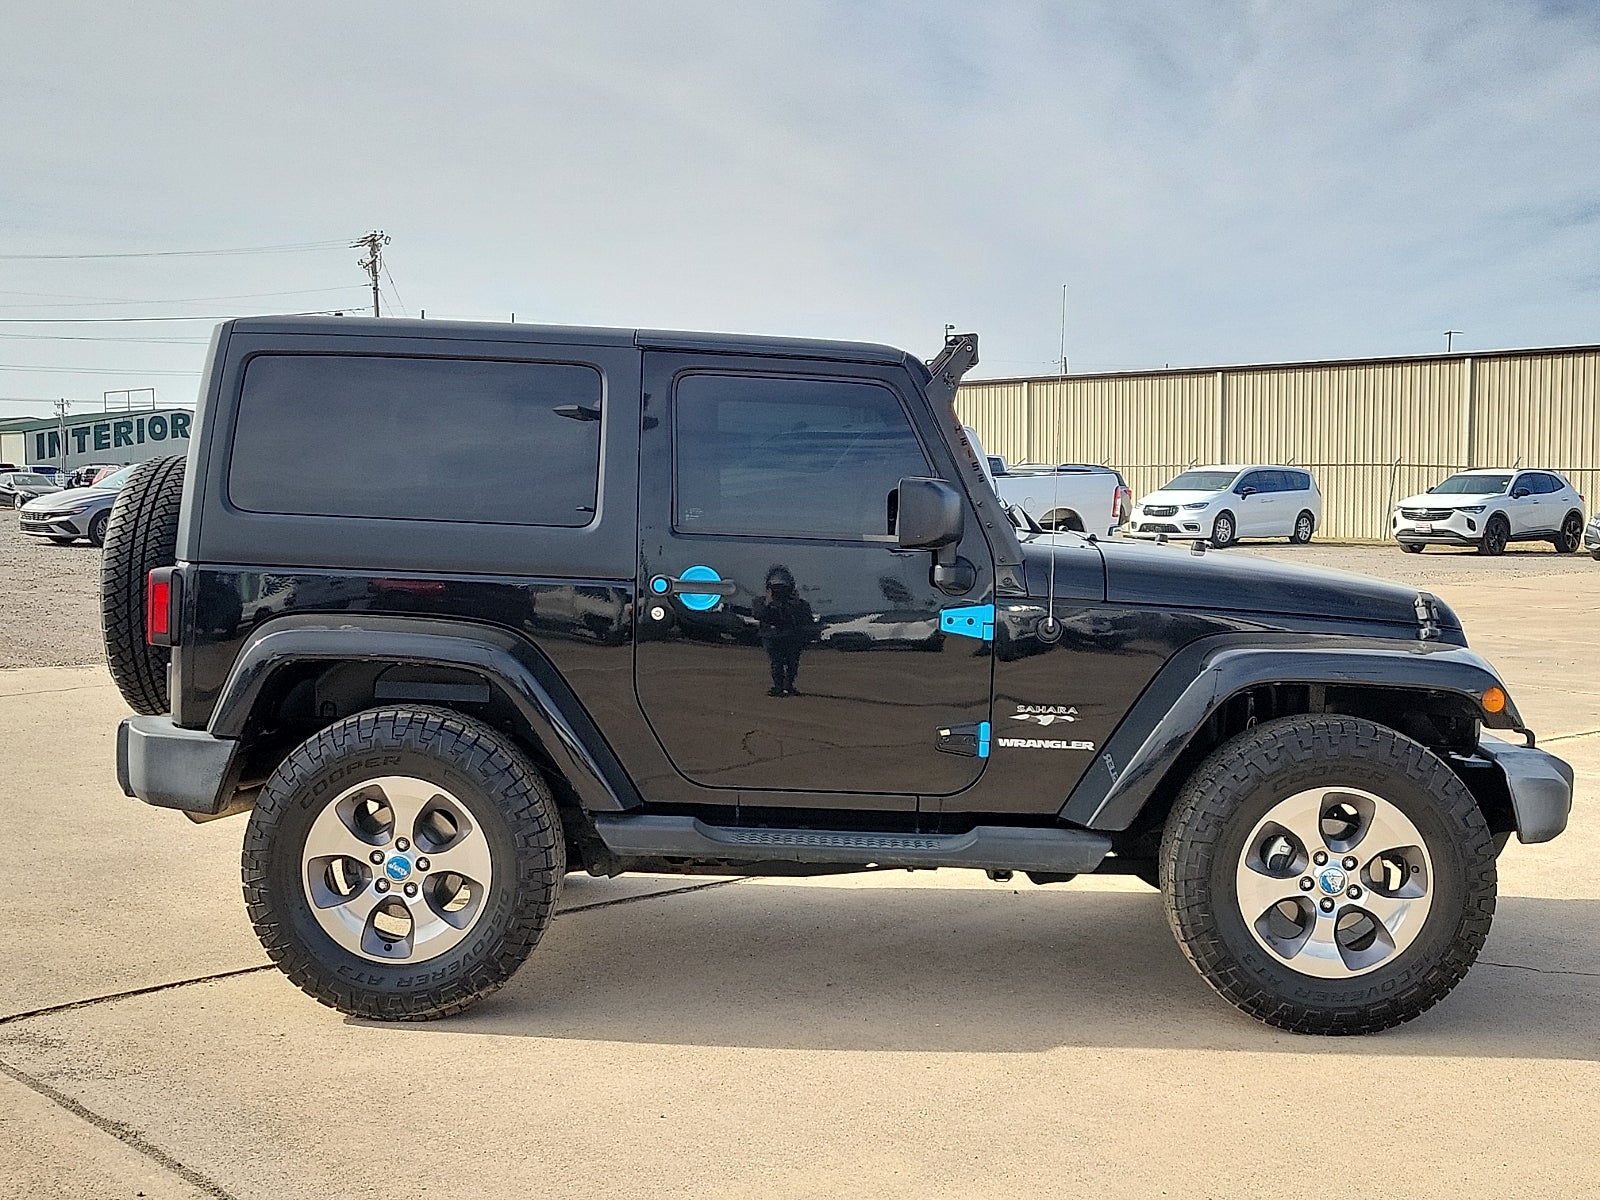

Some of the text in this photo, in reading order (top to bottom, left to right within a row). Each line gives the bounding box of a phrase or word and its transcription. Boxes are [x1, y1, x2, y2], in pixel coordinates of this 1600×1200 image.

[36, 413, 190, 460] INTERIOR
[1016, 704, 1079, 714] SAHARA
[998, 738, 1095, 751] WRANGLER
[300, 755, 400, 809] COOPER
[337, 889, 511, 987] DISCOVERER AT3
